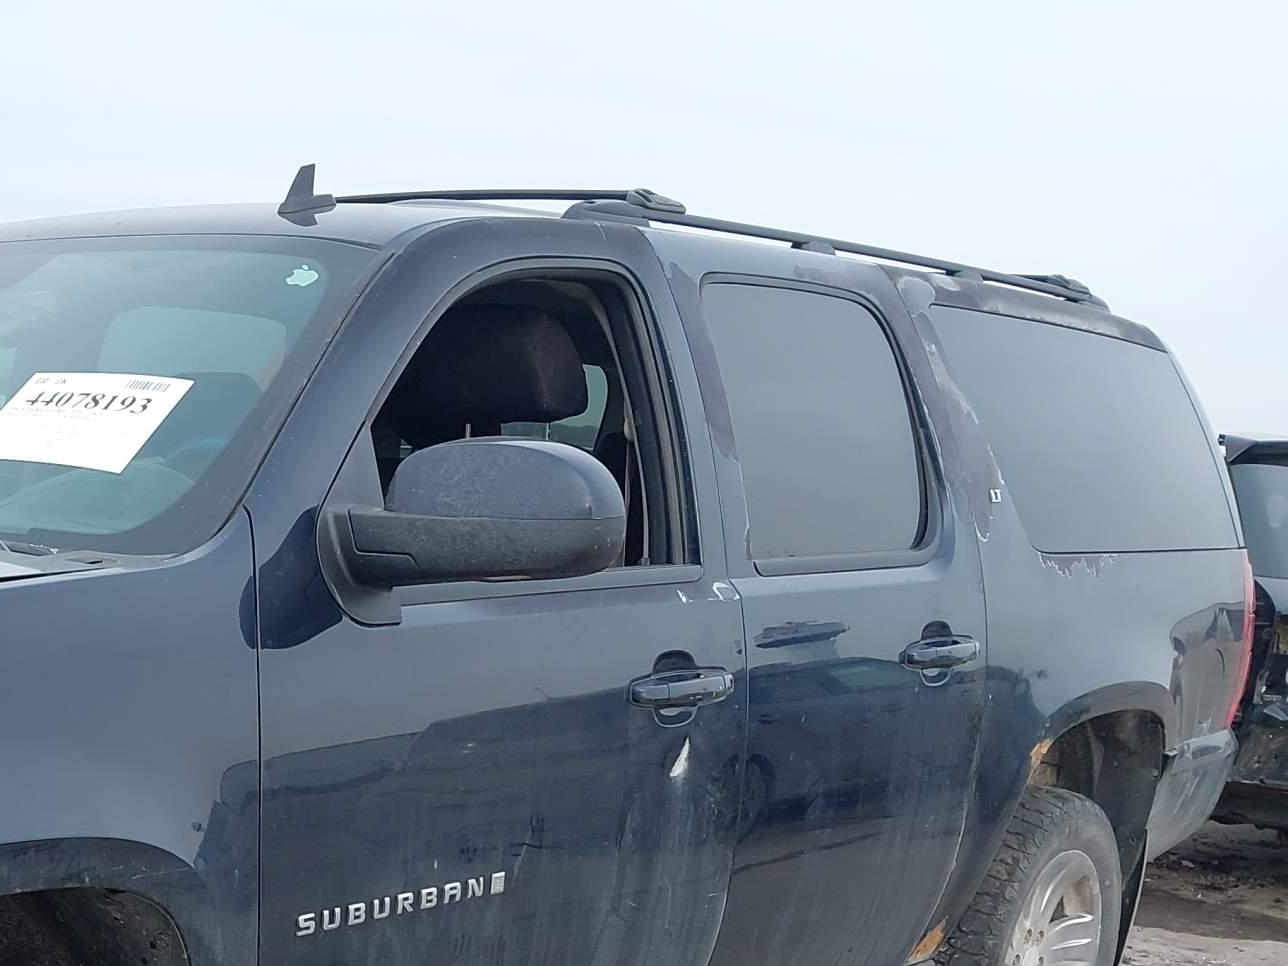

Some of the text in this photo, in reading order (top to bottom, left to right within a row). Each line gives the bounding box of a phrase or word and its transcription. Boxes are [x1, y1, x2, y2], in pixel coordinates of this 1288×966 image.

[25, 390, 153, 415] 44078193
[989, 488, 1002, 503] LT
[296, 876, 485, 936] SUBURBAN
